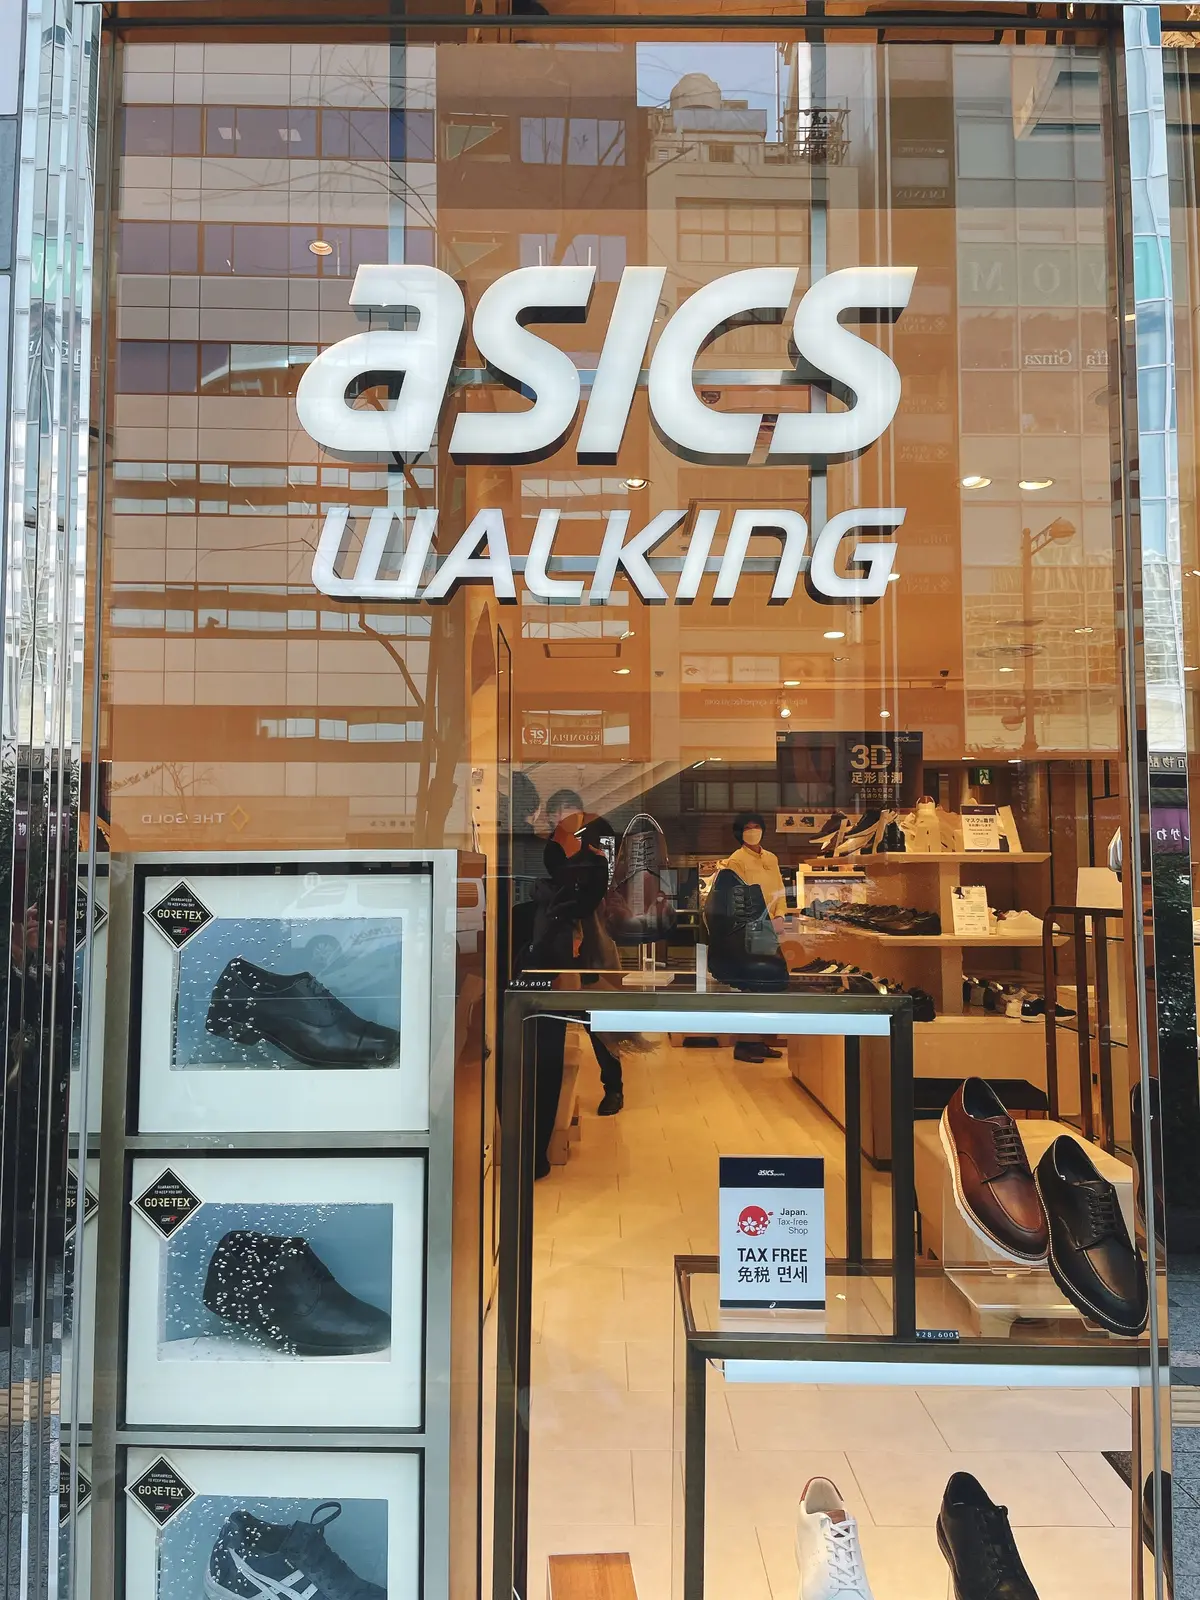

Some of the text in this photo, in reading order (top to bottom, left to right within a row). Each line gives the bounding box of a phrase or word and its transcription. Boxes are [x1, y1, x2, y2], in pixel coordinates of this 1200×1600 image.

[312, 507, 908, 599] WALKING
[850, 744, 893, 770] 3D
[851, 771, 903, 784] 足形計測
[157, 908, 202, 920] GORE-TEX
[144, 1197, 190, 1208] GORE-TEX
[780, 1208, 808, 1217] Japan.
[777, 1218, 808, 1226] Tax-free
[788, 1227, 808, 1235] Shop
[737, 1248, 808, 1262] TAX FREE
[738, 1266, 808, 1283] 免税 면세
[138, 1485, 184, 1497] GORE-TEX
